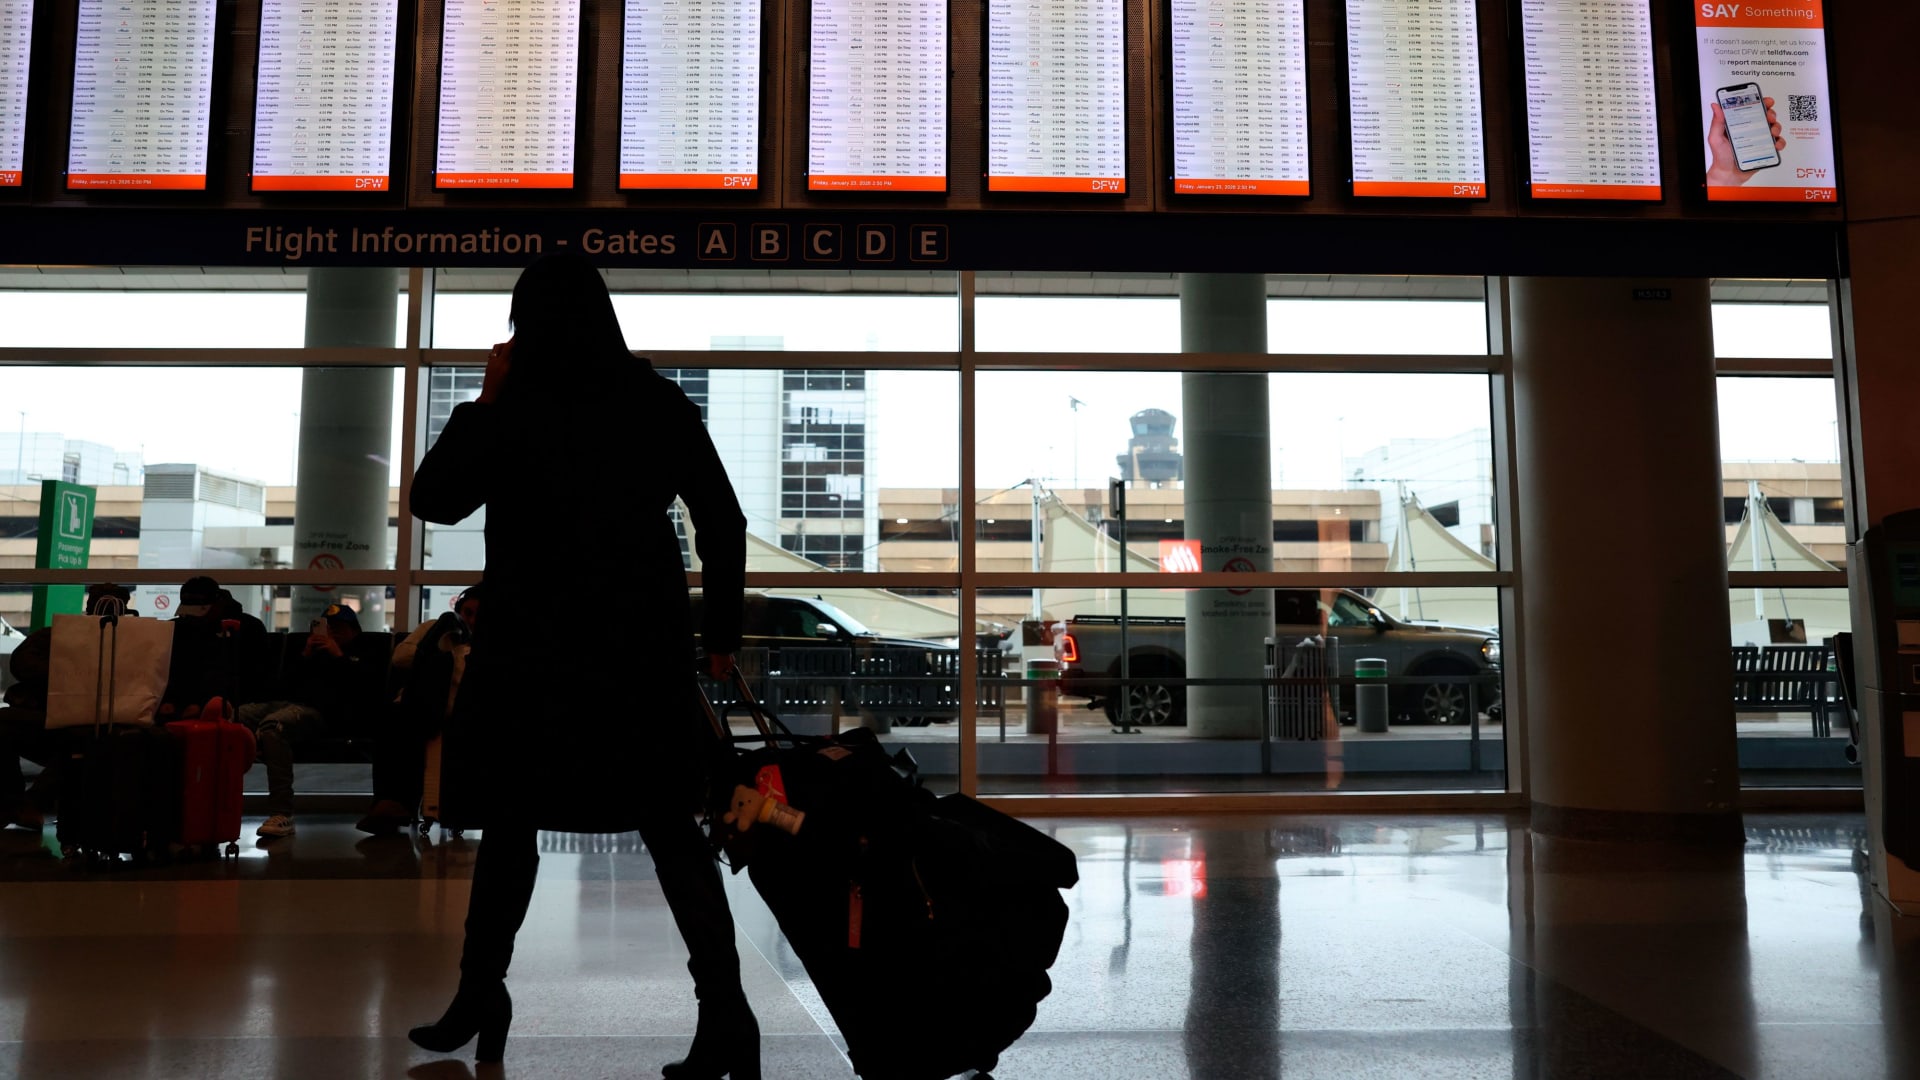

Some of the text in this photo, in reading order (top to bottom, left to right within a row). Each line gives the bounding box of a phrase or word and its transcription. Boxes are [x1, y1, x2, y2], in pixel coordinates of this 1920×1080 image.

[1702, 4, 1816, 20] SAY Something.
[1796, 168, 1826, 178] DFW
[356, 178, 382, 188] DFW
[724, 176, 752, 186] DFW
[1092, 180, 1120, 190] DFW
[1454, 186, 1480, 194] DFW
[1805, 190, 1831, 200] DFW
[246, 227, 337, 260] Flight
[353, 226, 542, 254] Information
[582, 228, 676, 255] Gates
[705, 230, 728, 254] A
[760, 230, 780, 254] B
[812, 230, 834, 255] C
[866, 230, 887, 255] D
[920, 231, 938, 256] E
[58, 542, 84, 554] Passenger
[58, 554, 68, 563] Pick
[70, 556, 77, 566] Up
